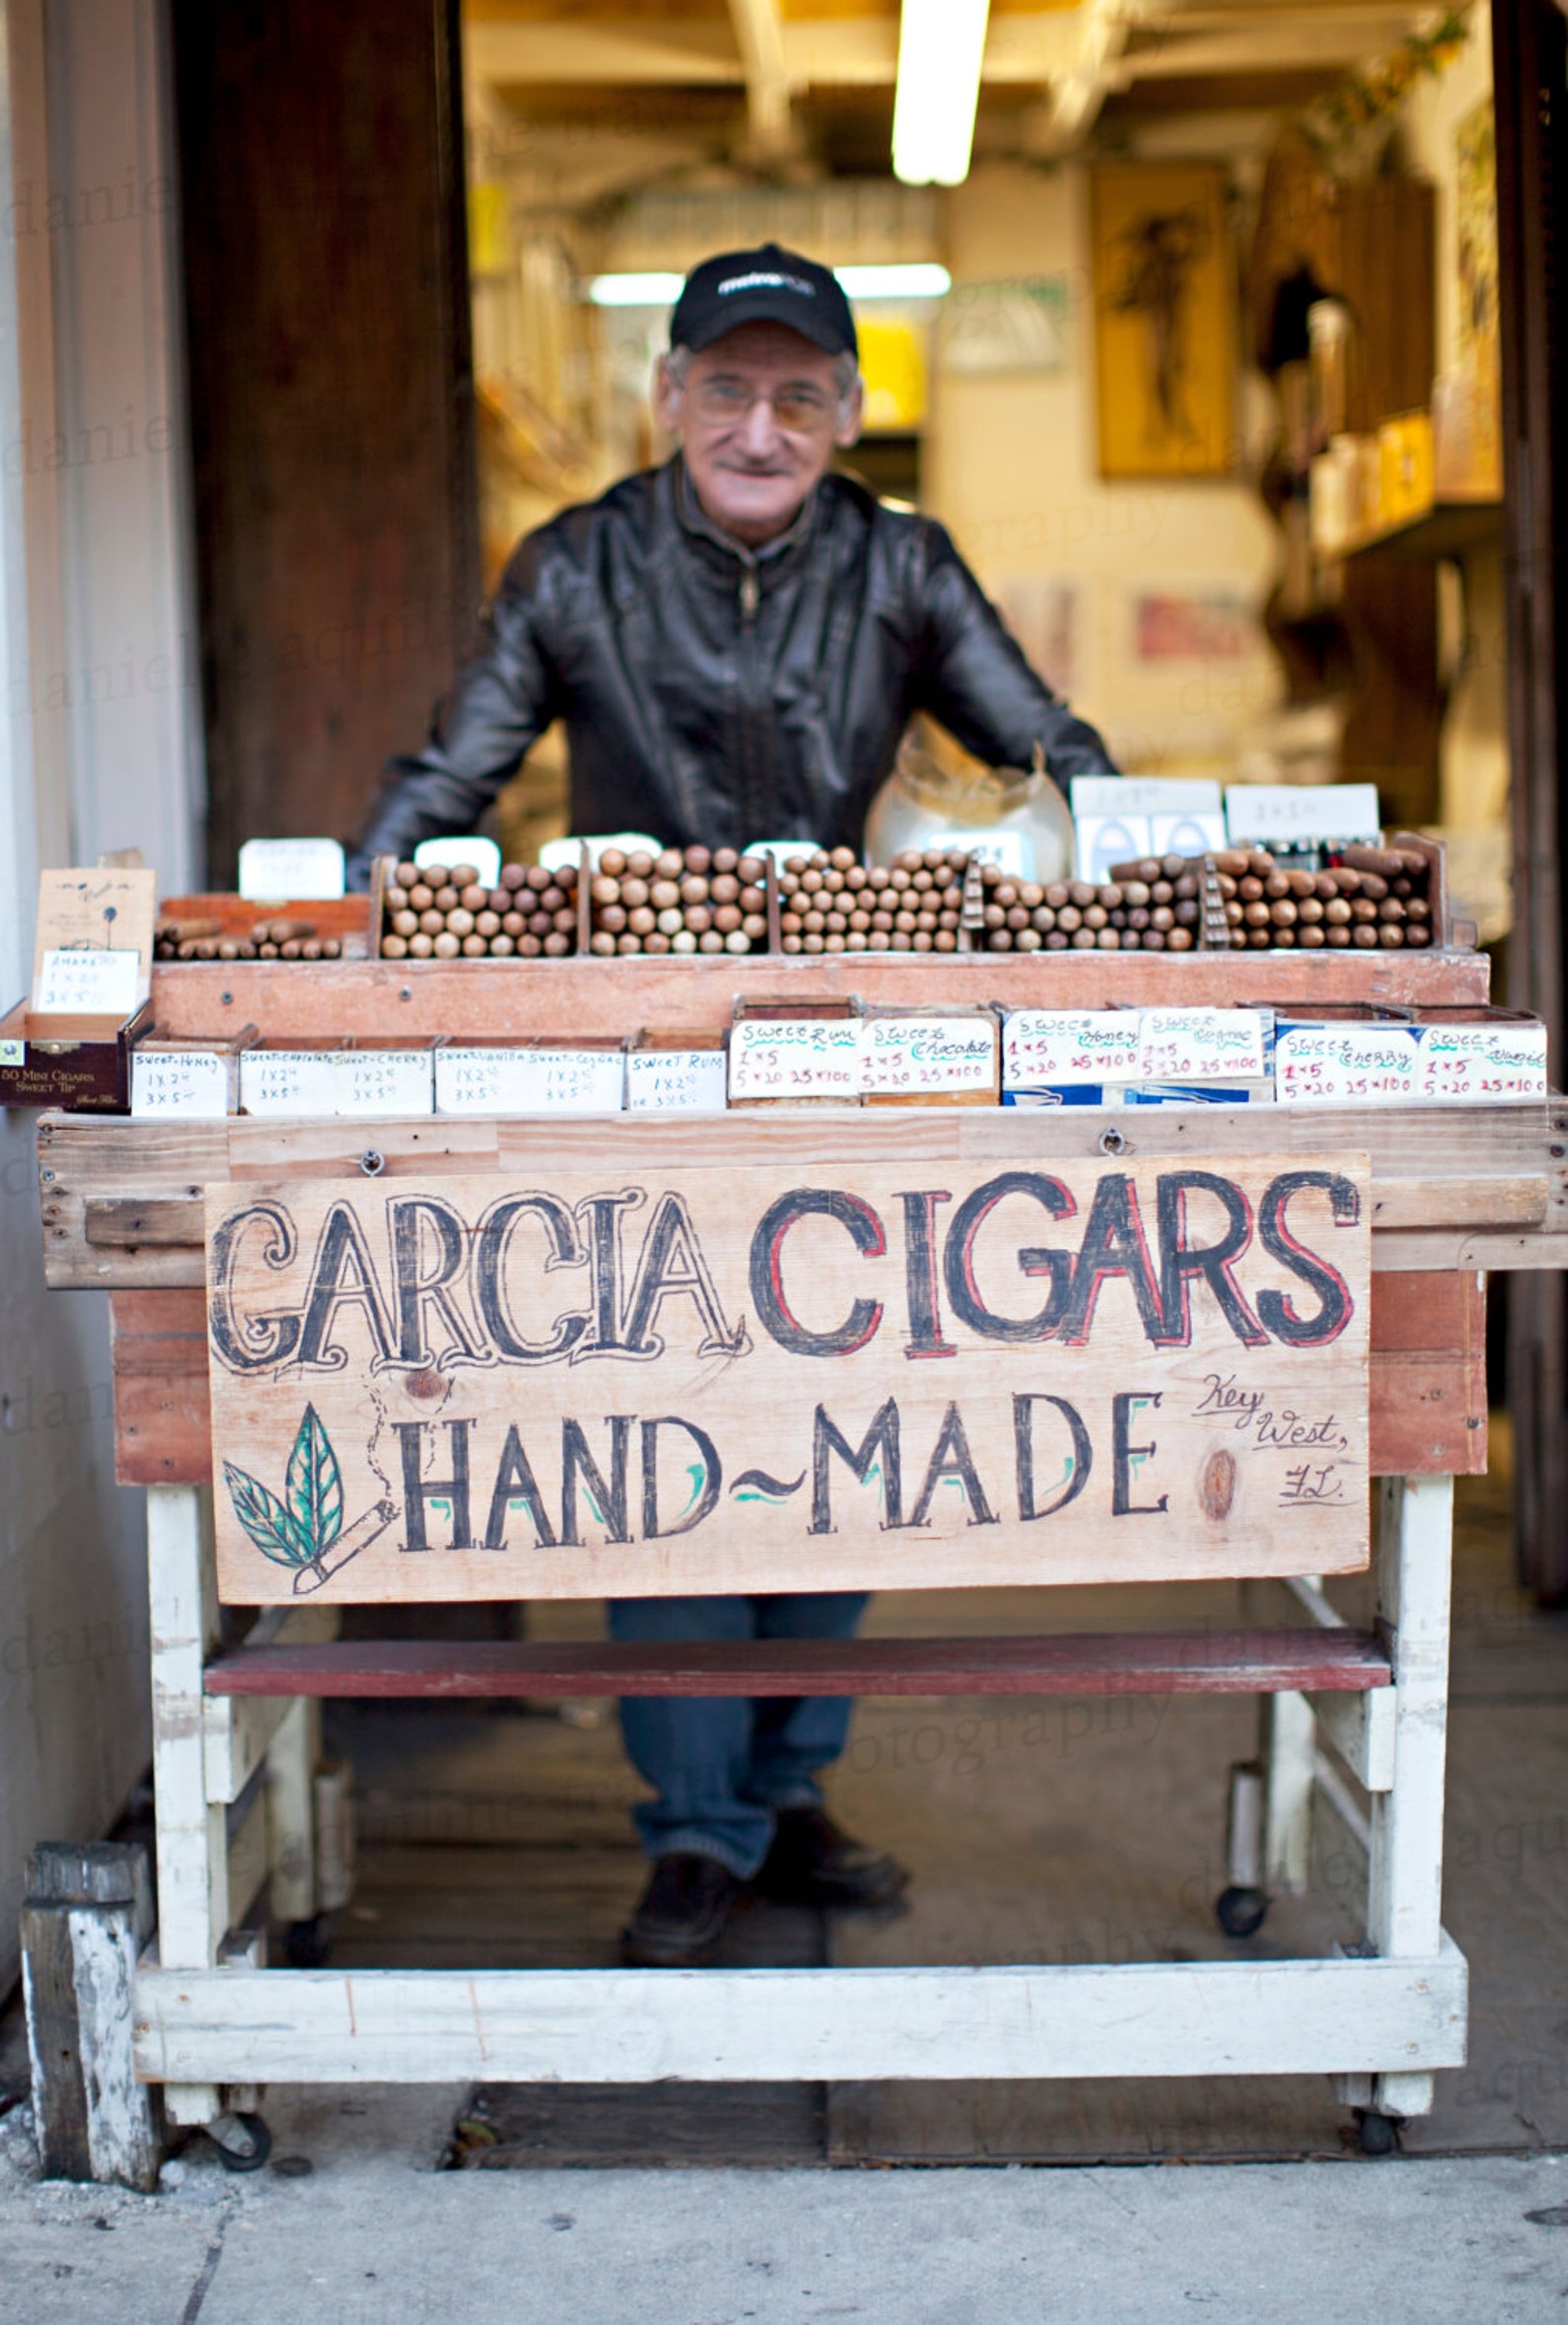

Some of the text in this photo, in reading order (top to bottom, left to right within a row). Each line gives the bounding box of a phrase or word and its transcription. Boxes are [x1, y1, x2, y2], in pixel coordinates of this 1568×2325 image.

[209, 1170, 1360, 1381] GARCIA CIGARS
[1197, 1374, 1265, 1429] Key
